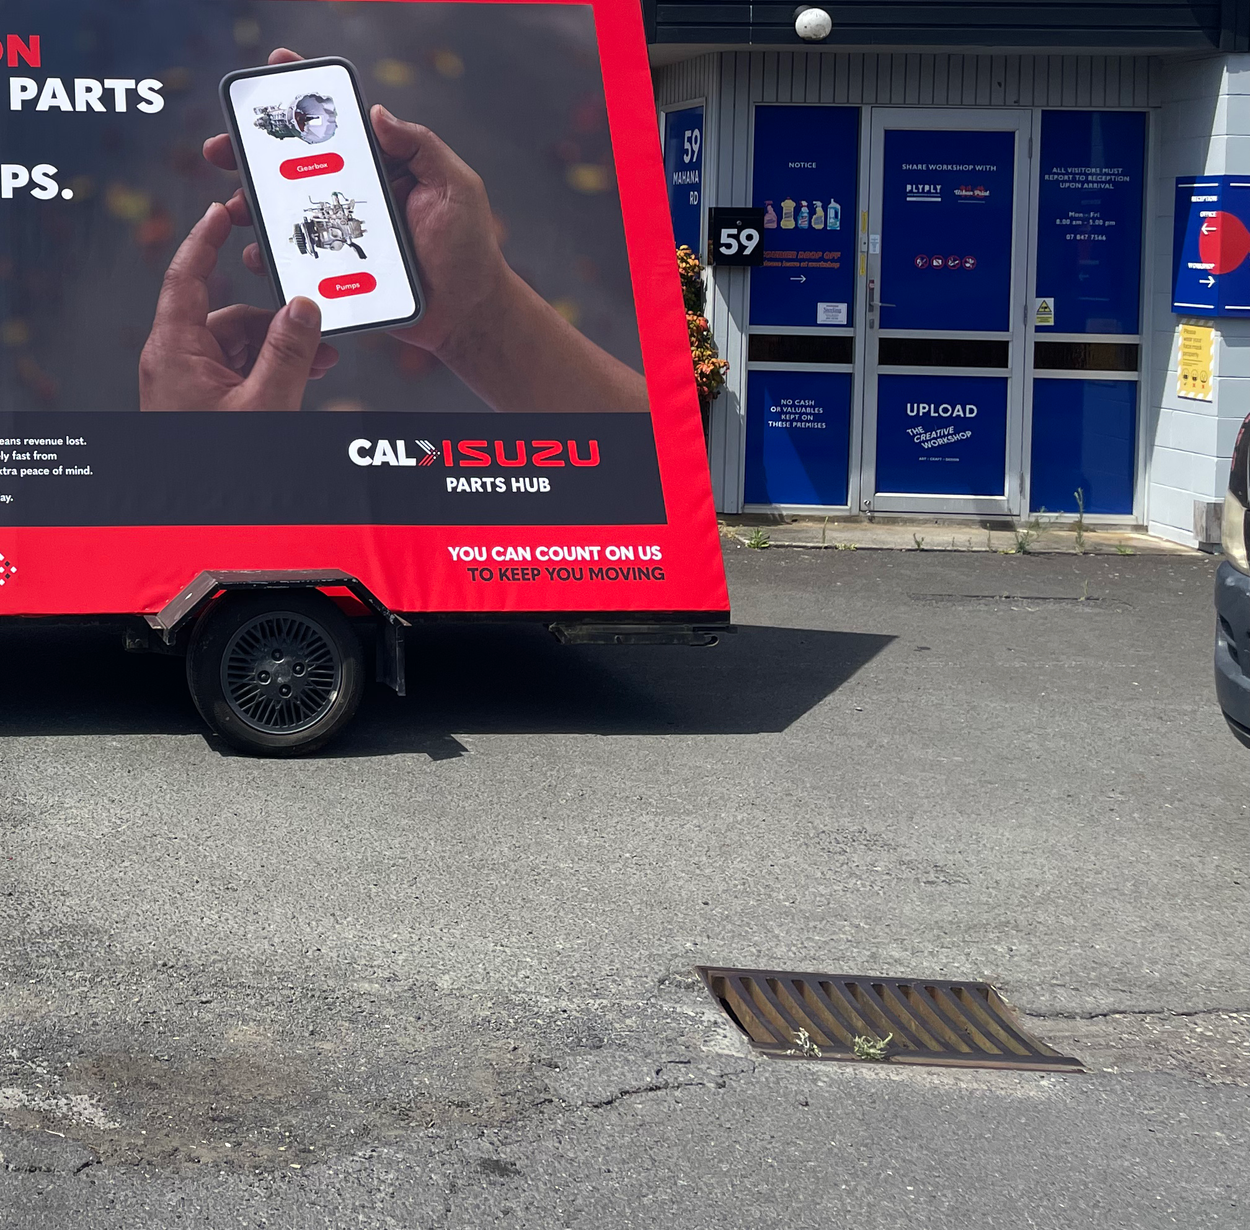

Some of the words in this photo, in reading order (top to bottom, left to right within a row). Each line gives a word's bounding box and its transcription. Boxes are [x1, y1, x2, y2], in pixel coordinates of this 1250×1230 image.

[10, 77, 165, 114] PARTS
[684, 129, 700, 163] 59
[296, 162, 328, 172] Gearbox
[673, 170, 699, 185] MAHANA
[906, 184, 942, 193] PLYPLY
[690, 192, 698, 205] RD
[719, 228, 760, 255] 59
[336, 281, 360, 291] Pumps
[907, 403, 978, 417] UPLOAD
[906, 426, 925, 436] THE
[914, 426, 954, 443] CREATIVE
[23, 438, 64, 446] revenue
[65, 436, 87, 446] lost.
[921, 431, 972, 449] WORKSHOP
[11, 451, 30, 461] fast
[32, 451, 57, 461] from
[348, 439, 417, 466] CAL
[442, 440, 600, 467] ISUZU
[20, 468, 49, 478] peace
[52, 465, 63, 476] of
[65, 465, 93, 476] mind.
[446, 478, 506, 492] PARTS
[511, 478, 550, 492] HUB
[448, 546, 487, 561] YOU
[492, 546, 531, 561] CAN
[536, 546, 601, 561] COUNT
[605, 546, 634, 560] ON
[638, 546, 662, 560] US
[467, 568, 494, 582] TO
[499, 568, 541, 581] KEEP
[545, 568, 584, 581] YOU
[589, 567, 665, 580] MOVING
